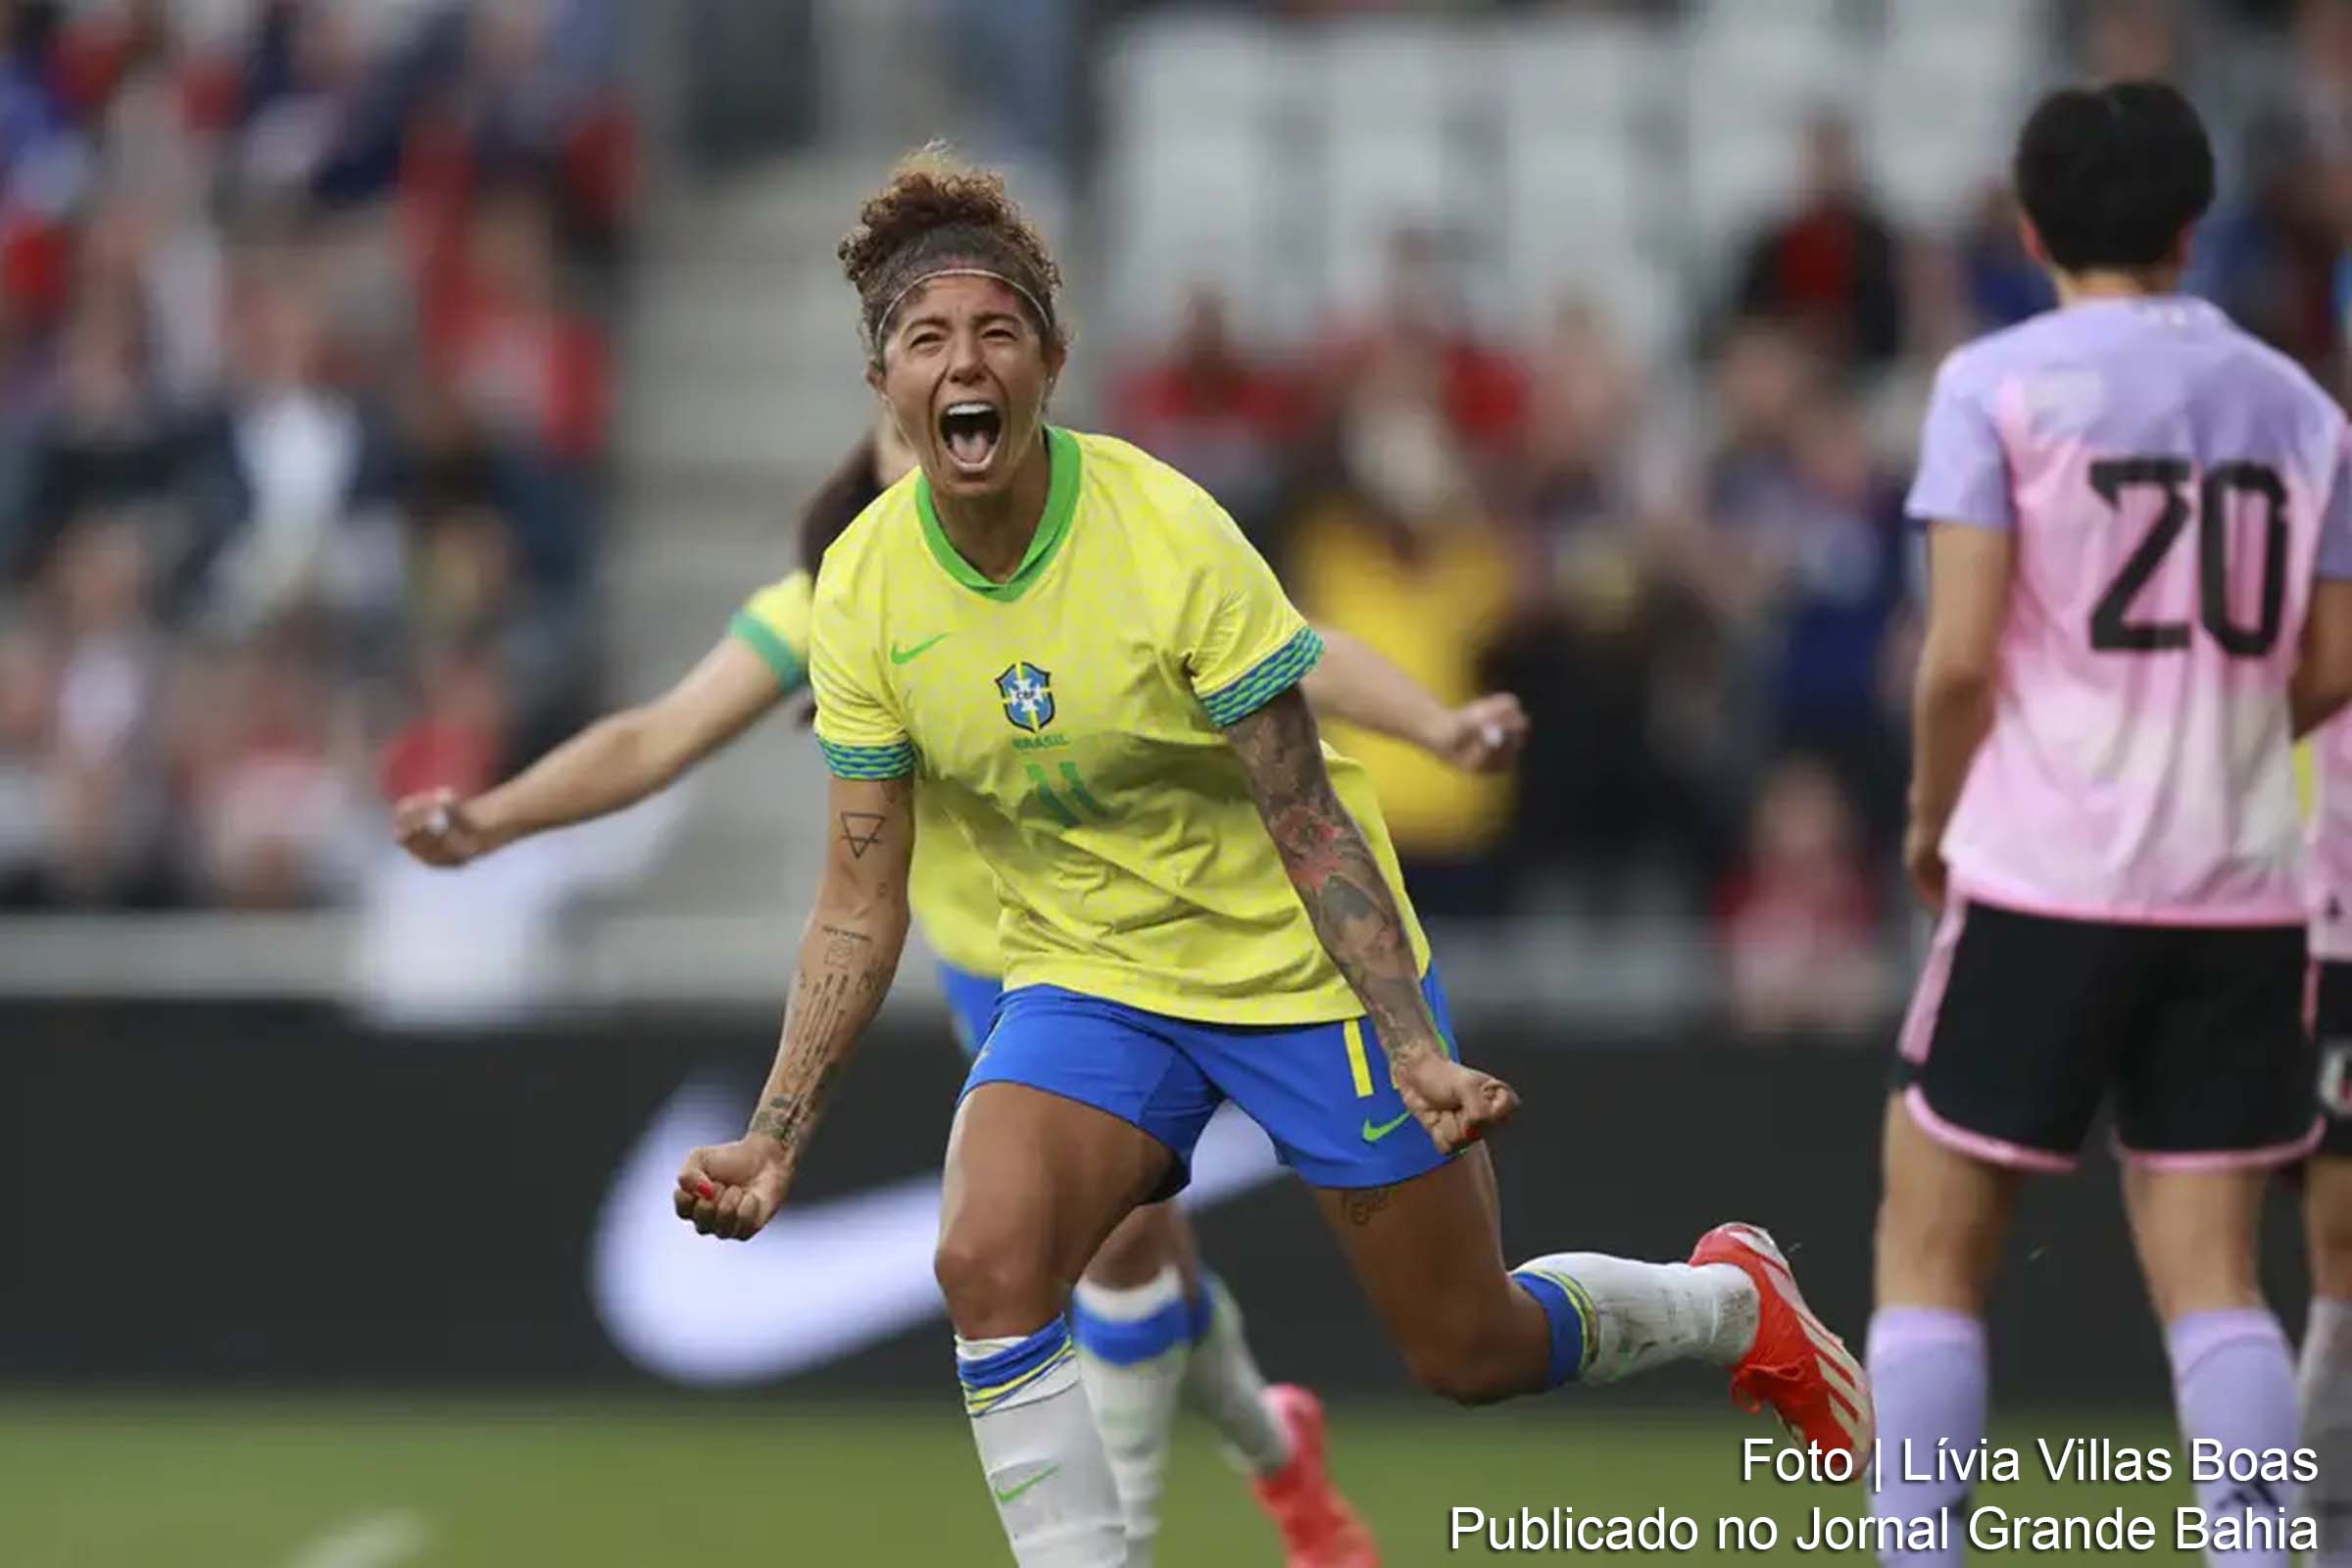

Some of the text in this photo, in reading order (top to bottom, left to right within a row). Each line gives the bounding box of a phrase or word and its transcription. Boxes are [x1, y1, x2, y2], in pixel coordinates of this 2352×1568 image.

[2088, 457, 2289, 657] 20
[1011, 734, 1068, 750] BRASIL
[1024, 761, 1105, 828] 11
